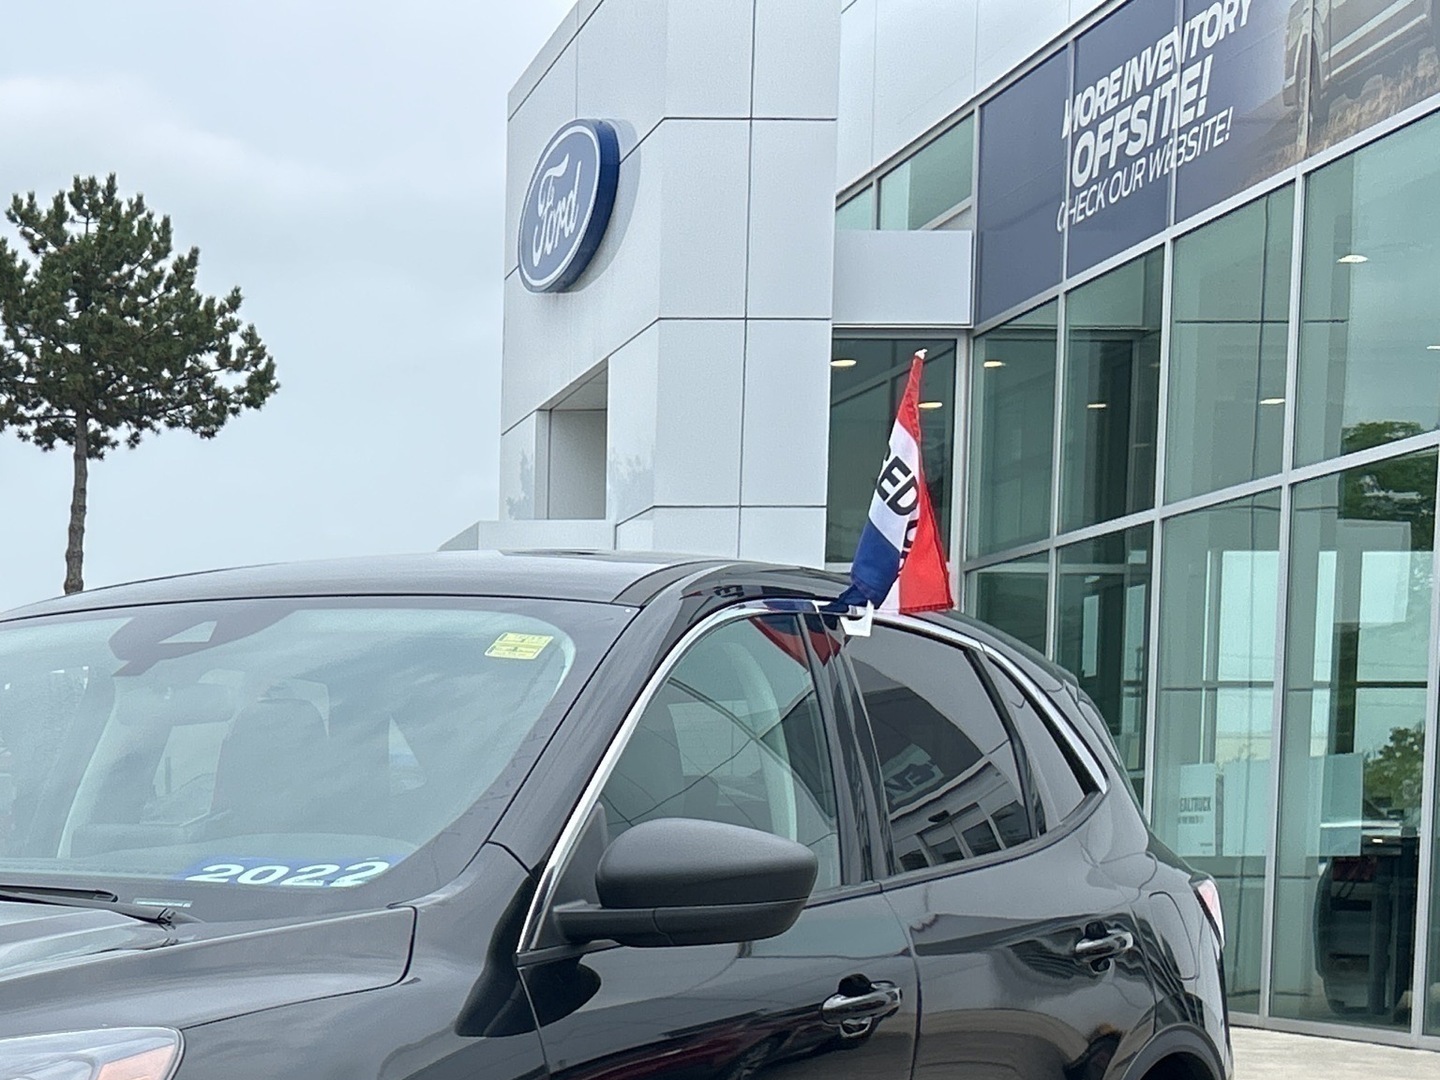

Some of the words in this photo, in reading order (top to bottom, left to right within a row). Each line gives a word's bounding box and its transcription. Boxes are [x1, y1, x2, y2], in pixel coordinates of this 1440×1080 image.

[1062, 65, 1124, 139] MORE
[1121, 0, 1253, 104] INVENTORY
[1071, 54, 1214, 188] OFFSITE!
[532, 152, 582, 267] Ford
[1056, 177, 1108, 233] CHECK
[1109, 157, 1147, 204] OUR
[1149, 106, 1234, 183] WEBSITE!
[185, 861, 390, 888] 2022
